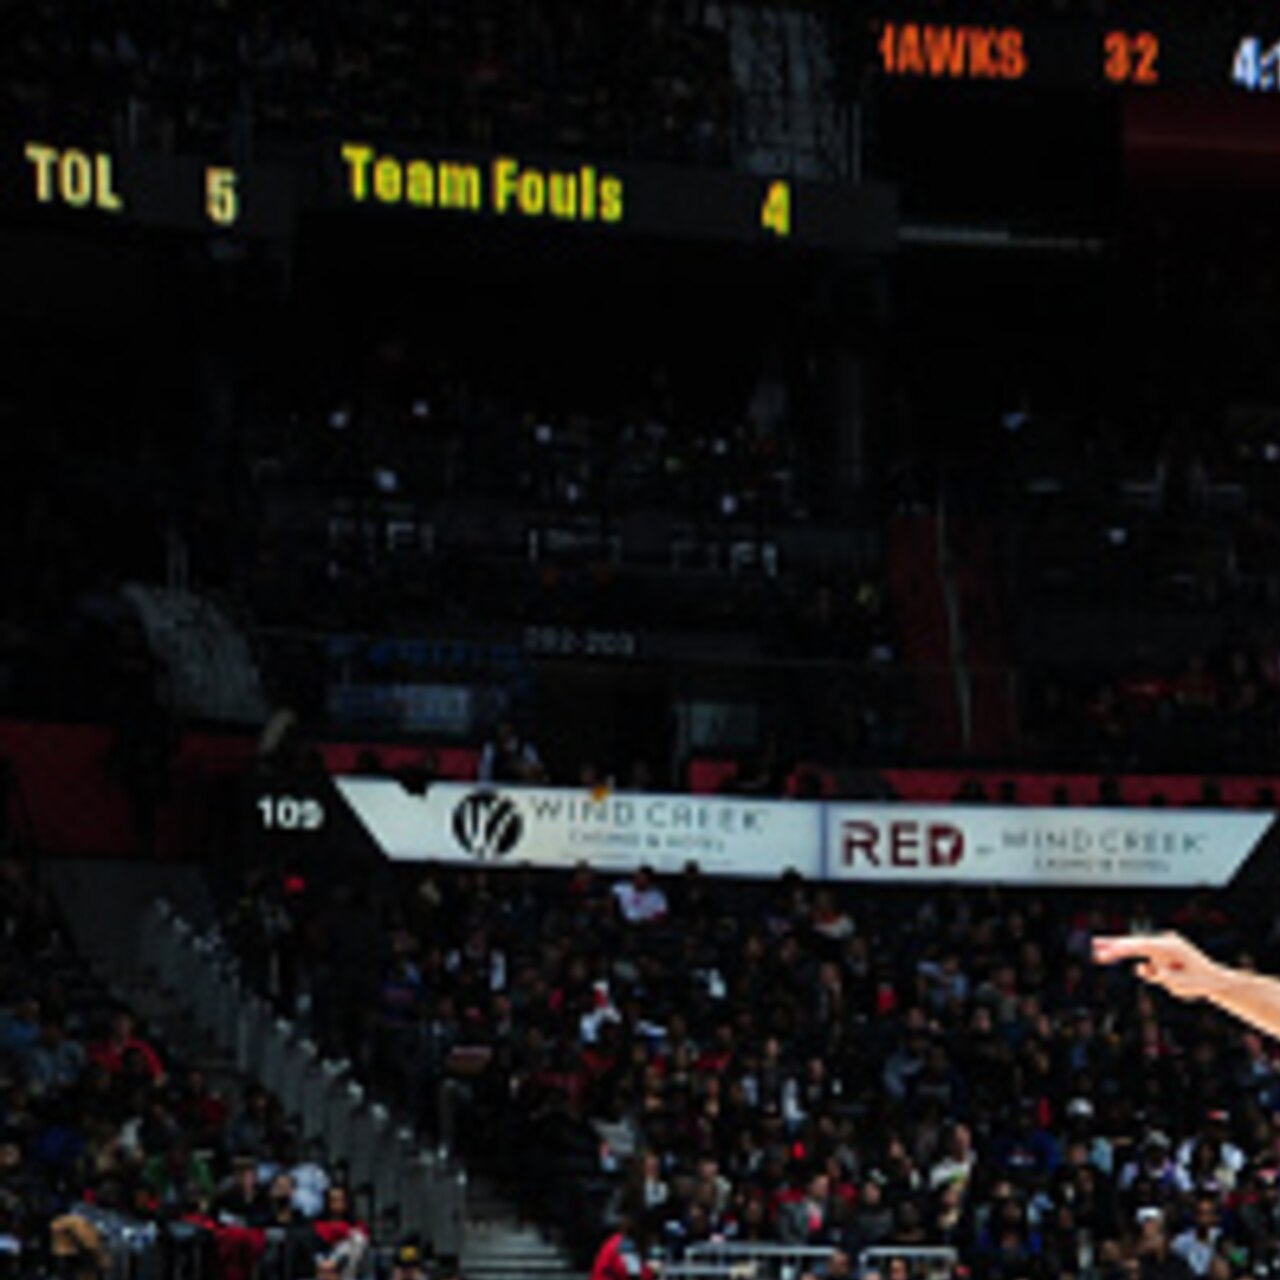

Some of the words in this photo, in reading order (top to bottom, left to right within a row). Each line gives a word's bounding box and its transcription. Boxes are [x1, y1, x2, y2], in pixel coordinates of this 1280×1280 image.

[1103, 30, 1159, 83] 32
[24, 143, 122, 211] TOL
[205, 166, 238, 225] 5
[340, 144, 482, 211] Team
[492, 157, 624, 223] Fouls
[760, 181, 791, 235] 4
[840, 820, 966, 868] RED
